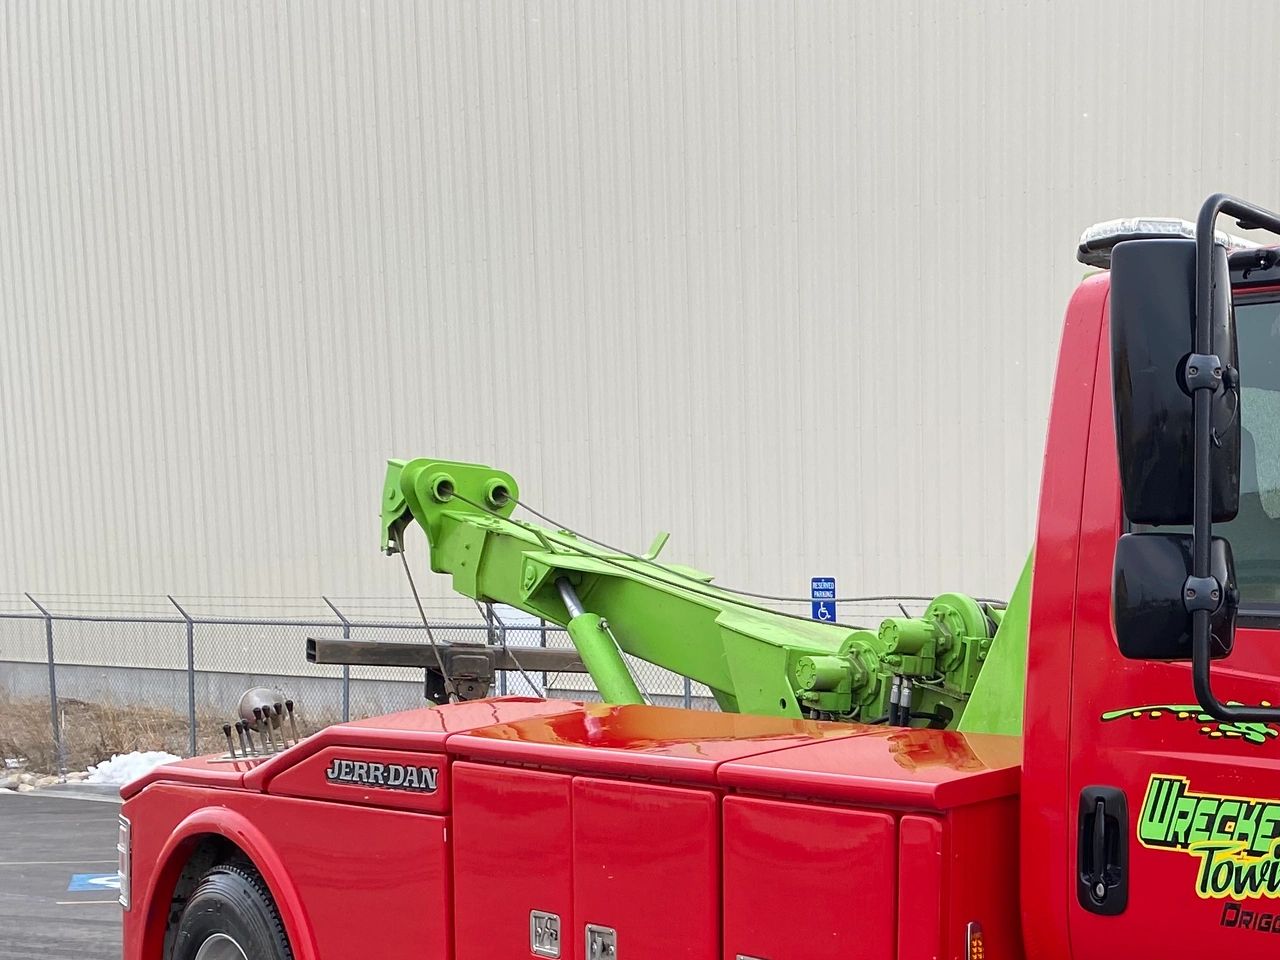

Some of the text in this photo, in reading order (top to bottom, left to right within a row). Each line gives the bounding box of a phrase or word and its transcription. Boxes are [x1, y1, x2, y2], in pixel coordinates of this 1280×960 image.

[812, 581, 835, 590] RESERVED
[813, 590, 834, 598] PARKING
[326, 759, 438, 789] JERR-DAN
